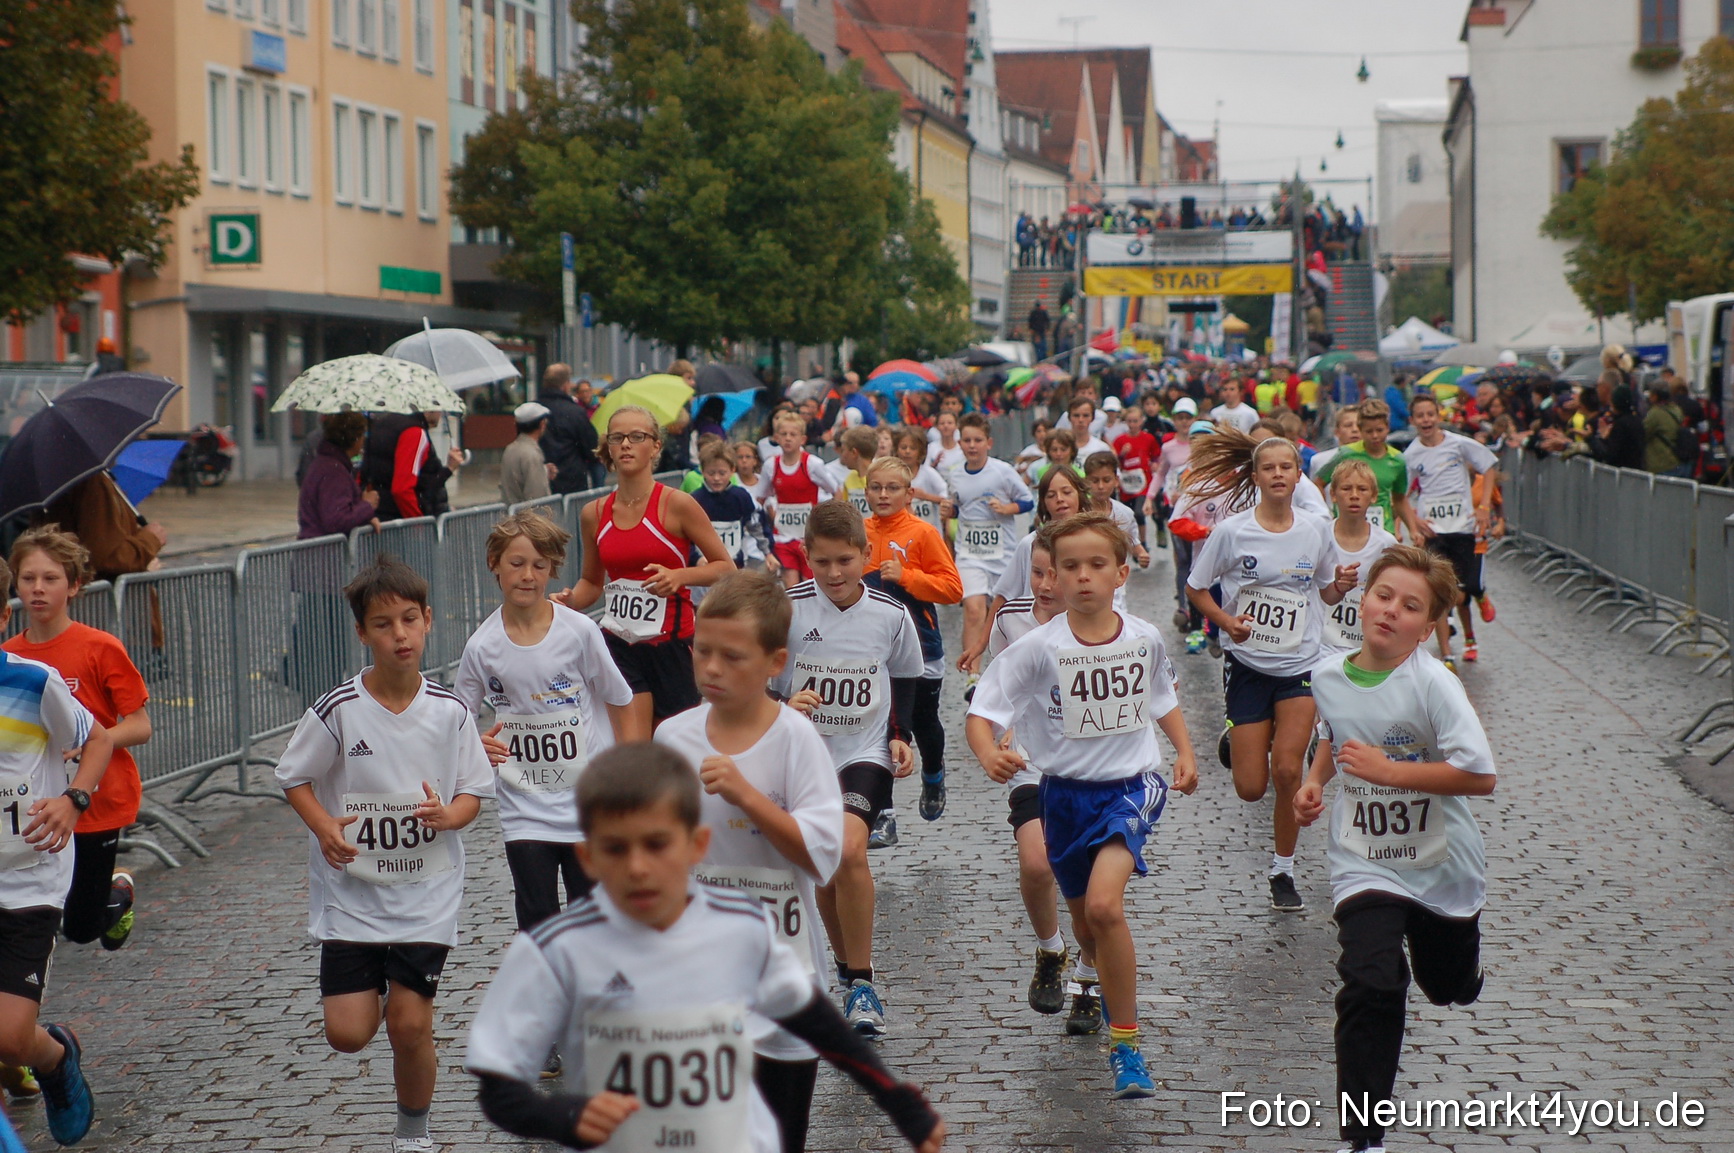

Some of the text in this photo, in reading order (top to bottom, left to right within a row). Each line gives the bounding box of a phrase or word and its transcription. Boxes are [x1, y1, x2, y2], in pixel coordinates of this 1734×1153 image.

[216, 220, 254, 258] D
[1152, 271, 1223, 291] START
[1429, 503, 1462, 519] 4047
[965, 530, 999, 546] 4039
[1241, 588, 1296, 606] PARTL Neumarkt
[610, 594, 658, 622] 4062
[1243, 600, 1297, 632] 4031
[1251, 630, 1280, 645] Teresa
[1059, 650, 1135, 667] PARTL Neumarkt
[795, 661, 867, 675] PARTL Neumarkt
[1070, 662, 1144, 702] 4052
[490, 694, 511, 703] PARTL
[800, 676, 872, 708] 4008
[525, 720, 567, 730] Neumarkt
[1079, 700, 1144, 734] ALEX
[348, 749, 373, 757] adidas
[508, 731, 578, 763] 4060
[518, 769, 566, 786] ALEX
[1343, 784, 1369, 796] PARTL
[346, 802, 380, 813] PARTL
[3, 800, 20, 836] 1
[1352, 798, 1431, 837] 4037
[1367, 844, 1417, 860] Ludwig
[377, 857, 424, 874] Philipp
[696, 874, 795, 892] PARTL Neumarkt
[588, 1021, 727, 1043] PARTL Neumarkt
[605, 1043, 737, 1109] 4030
[654, 1126, 696, 1148] Jan
